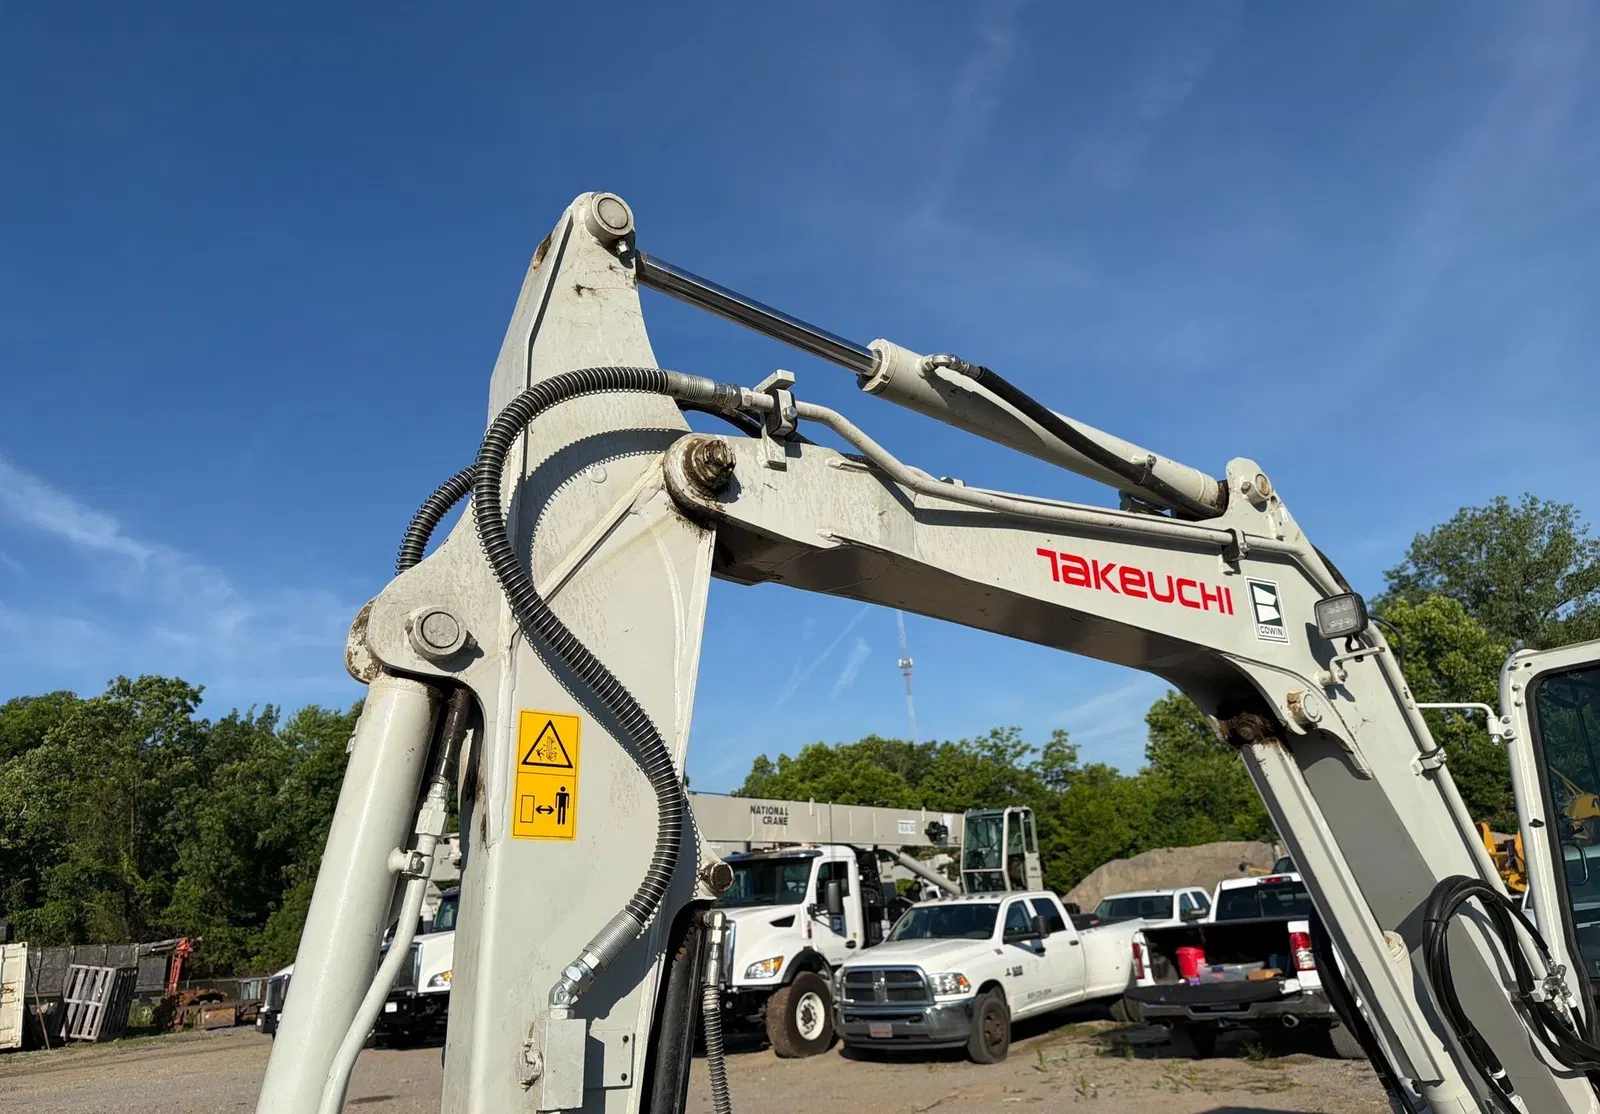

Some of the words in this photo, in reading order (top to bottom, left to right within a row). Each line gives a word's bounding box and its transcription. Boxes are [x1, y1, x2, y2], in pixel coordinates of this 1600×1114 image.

[1259, 625, 1283, 637] COWIN
[750, 804, 789, 816] NATIONAL
[762, 815, 788, 826] CRANE
